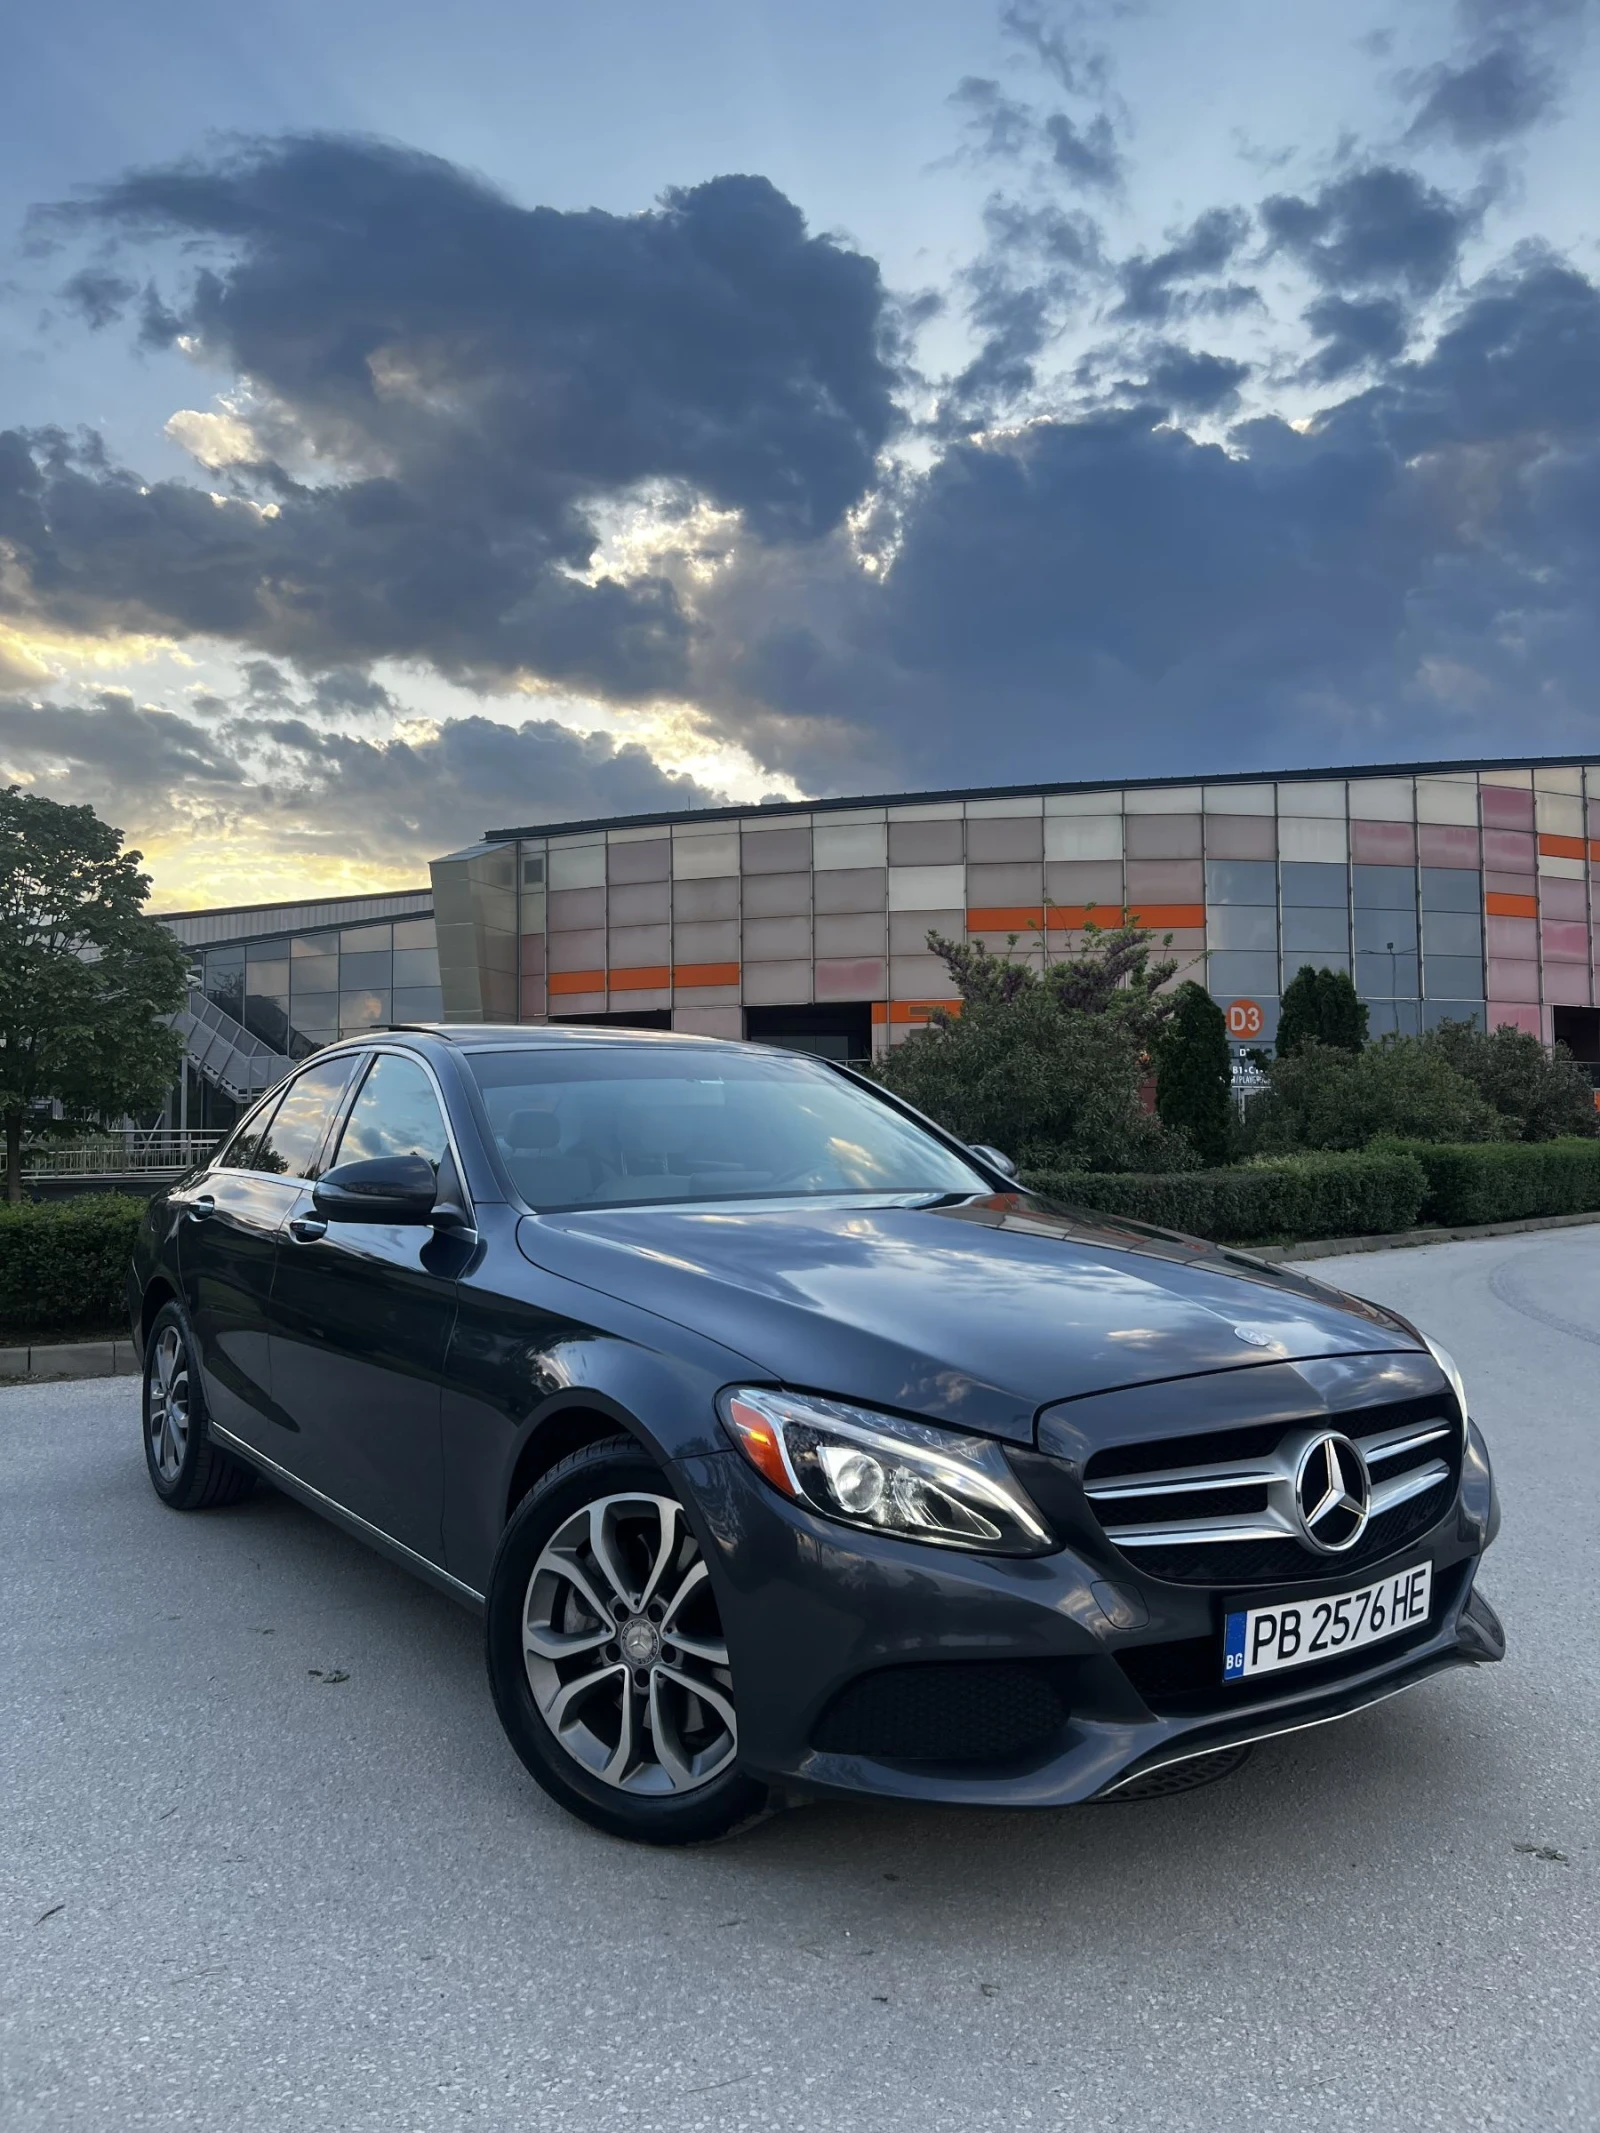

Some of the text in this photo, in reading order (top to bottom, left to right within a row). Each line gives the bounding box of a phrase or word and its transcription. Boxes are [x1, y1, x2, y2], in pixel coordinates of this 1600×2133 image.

[1231, 1006, 1260, 1031] D3
[1240, 1048, 1250, 1057] D
[1251, 1568, 1427, 1666] PB 2576 HE
[1226, 1653, 1243, 1670] BG
